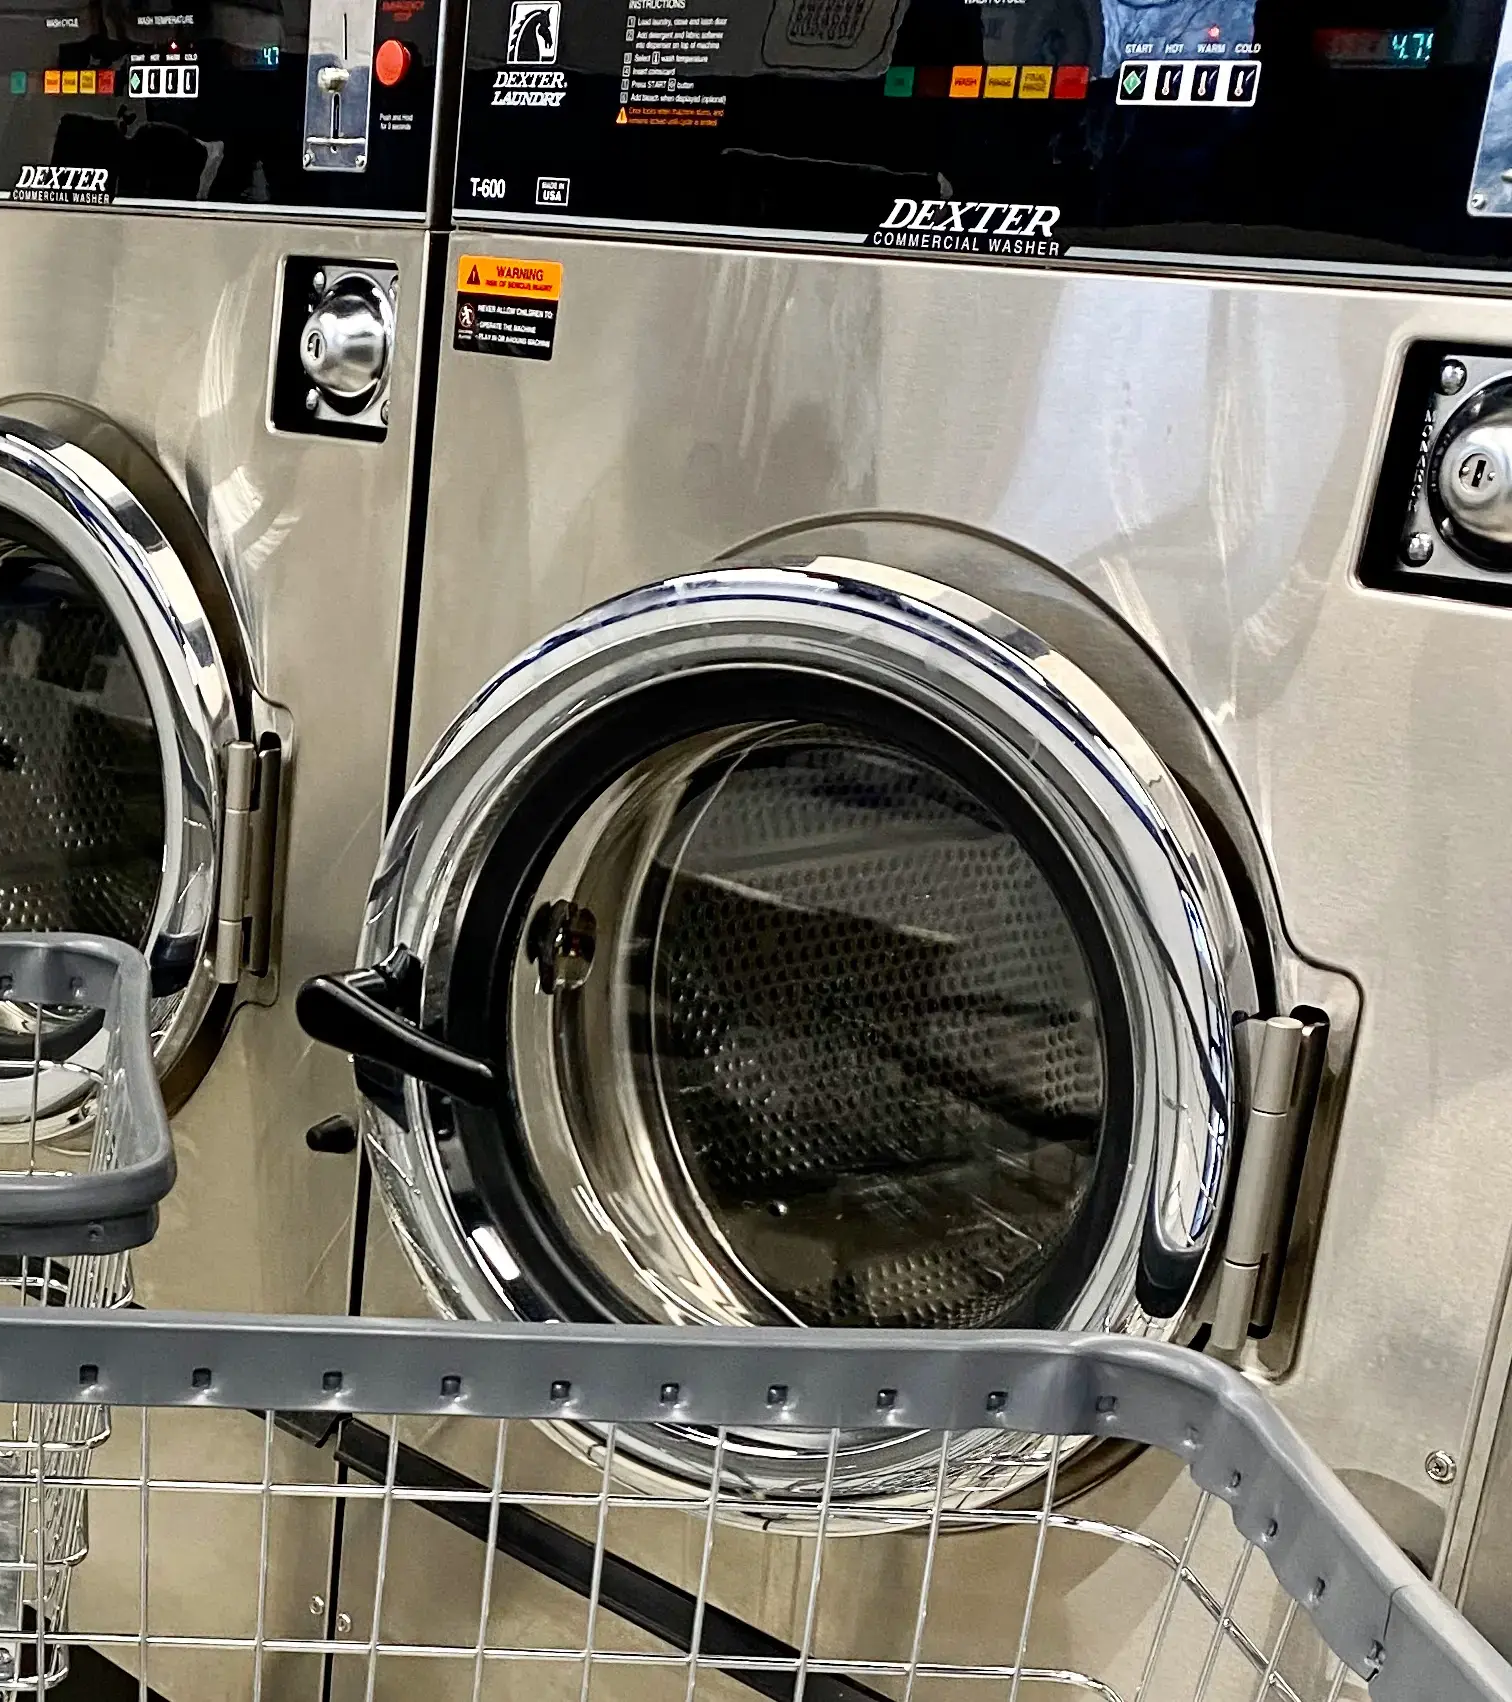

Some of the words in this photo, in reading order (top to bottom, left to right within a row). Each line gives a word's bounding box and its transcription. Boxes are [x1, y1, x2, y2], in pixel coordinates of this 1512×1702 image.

[1125, 43, 1154, 54] START
[1164, 43, 1185, 54] HOT
[1197, 43, 1226, 54] WARM
[1234, 43, 1262, 54] COLD
[490, 91, 567, 107] LAUNDRY
[15, 165, 109, 192] DEXTER
[470, 177, 506, 198] T-600
[542, 190, 563, 201] USA
[12, 188, 69, 203] COMMERCIAL
[72, 192, 110, 205] WASHER
[878, 198, 1061, 238] DEXTER
[872, 231, 980, 251] COMMERCIAL
[988, 238, 1060, 256] WASHER
[496, 265, 544, 282] WARNING
